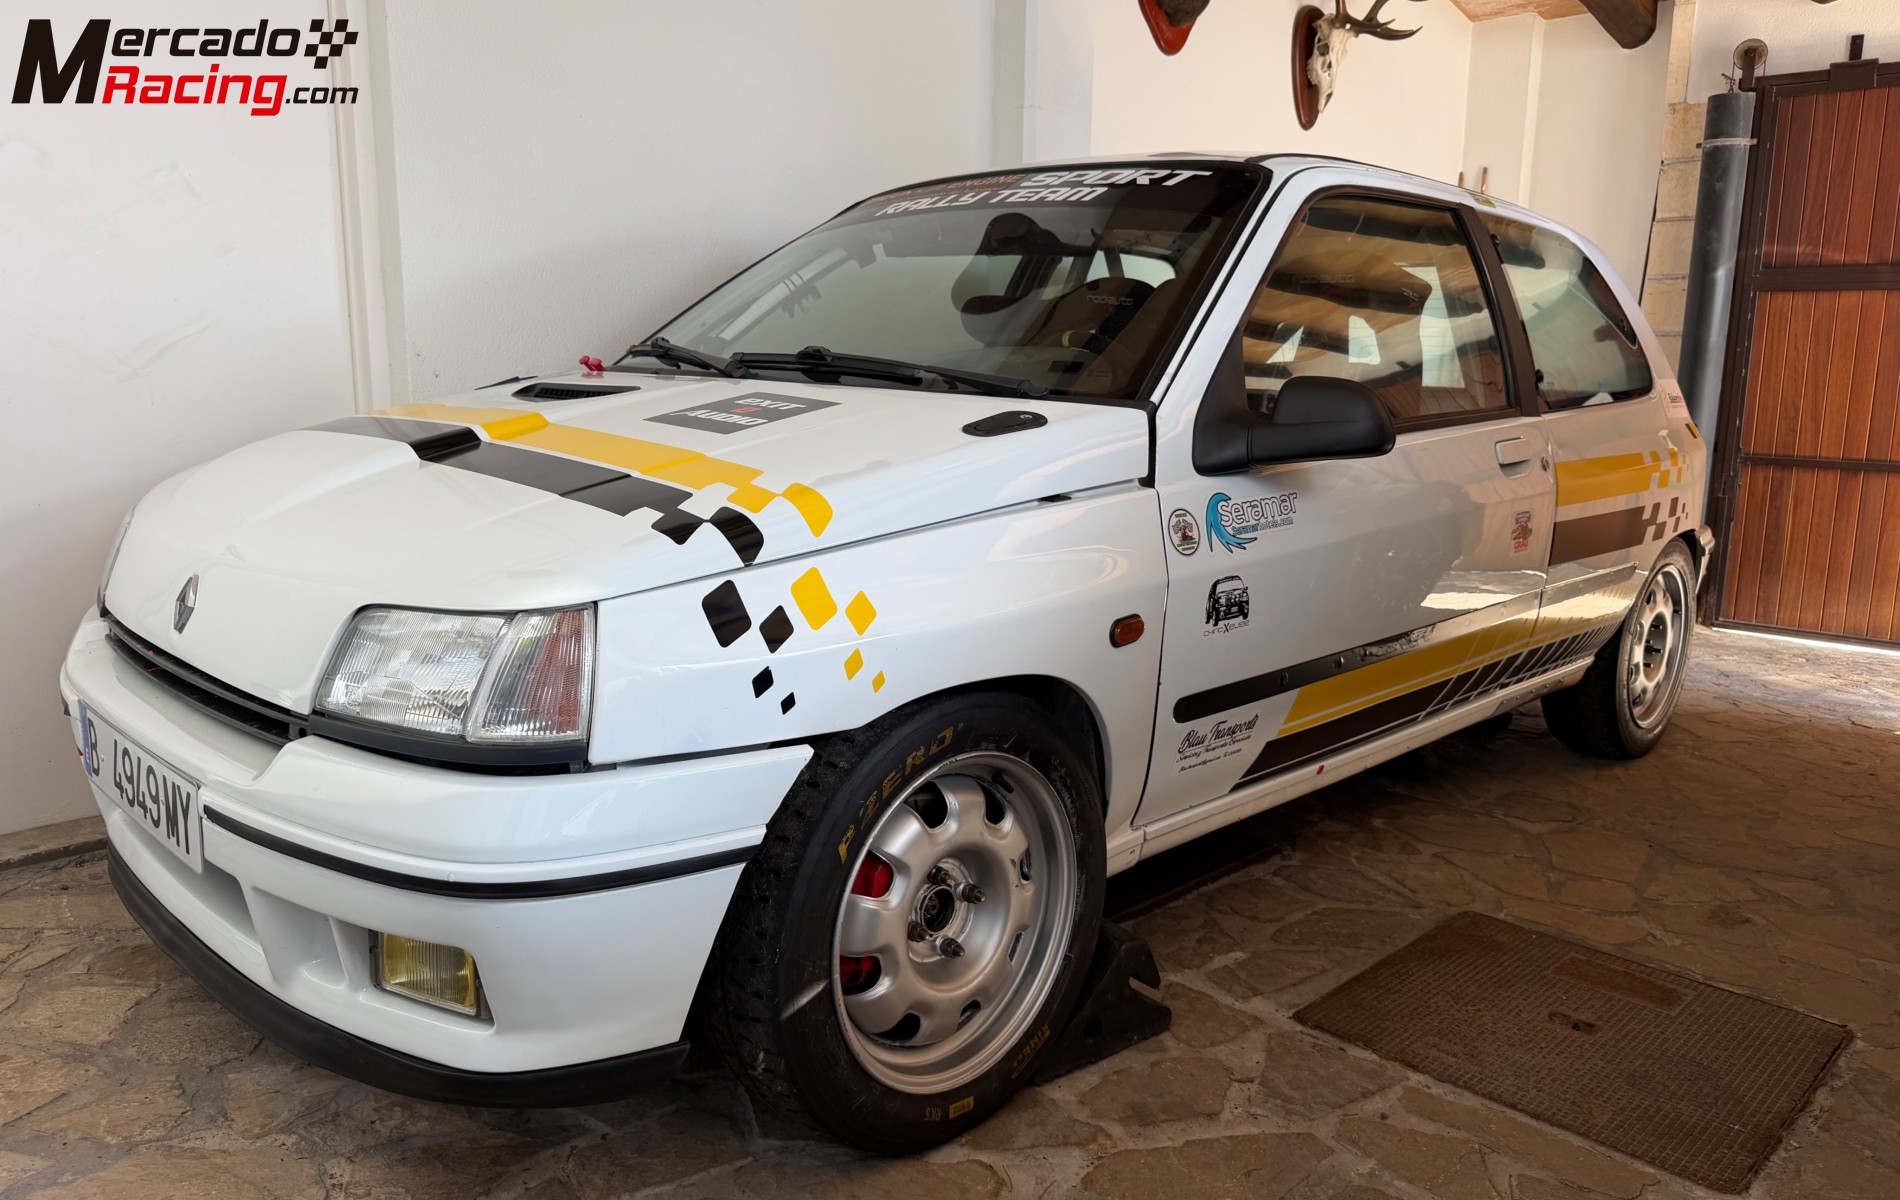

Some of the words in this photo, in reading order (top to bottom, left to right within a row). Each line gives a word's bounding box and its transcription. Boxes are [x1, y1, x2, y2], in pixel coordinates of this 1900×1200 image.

[1019, 169, 1213, 187] SPORT
[874, 190, 989, 217] RALLY
[987, 186, 1109, 204] TEAM
[1217, 491, 1298, 528] Seramar
[1178, 729, 1208, 754] Blau
[88, 717, 100, 777] B
[113, 738, 161, 829] 4949
[162, 774, 191, 855] MY
